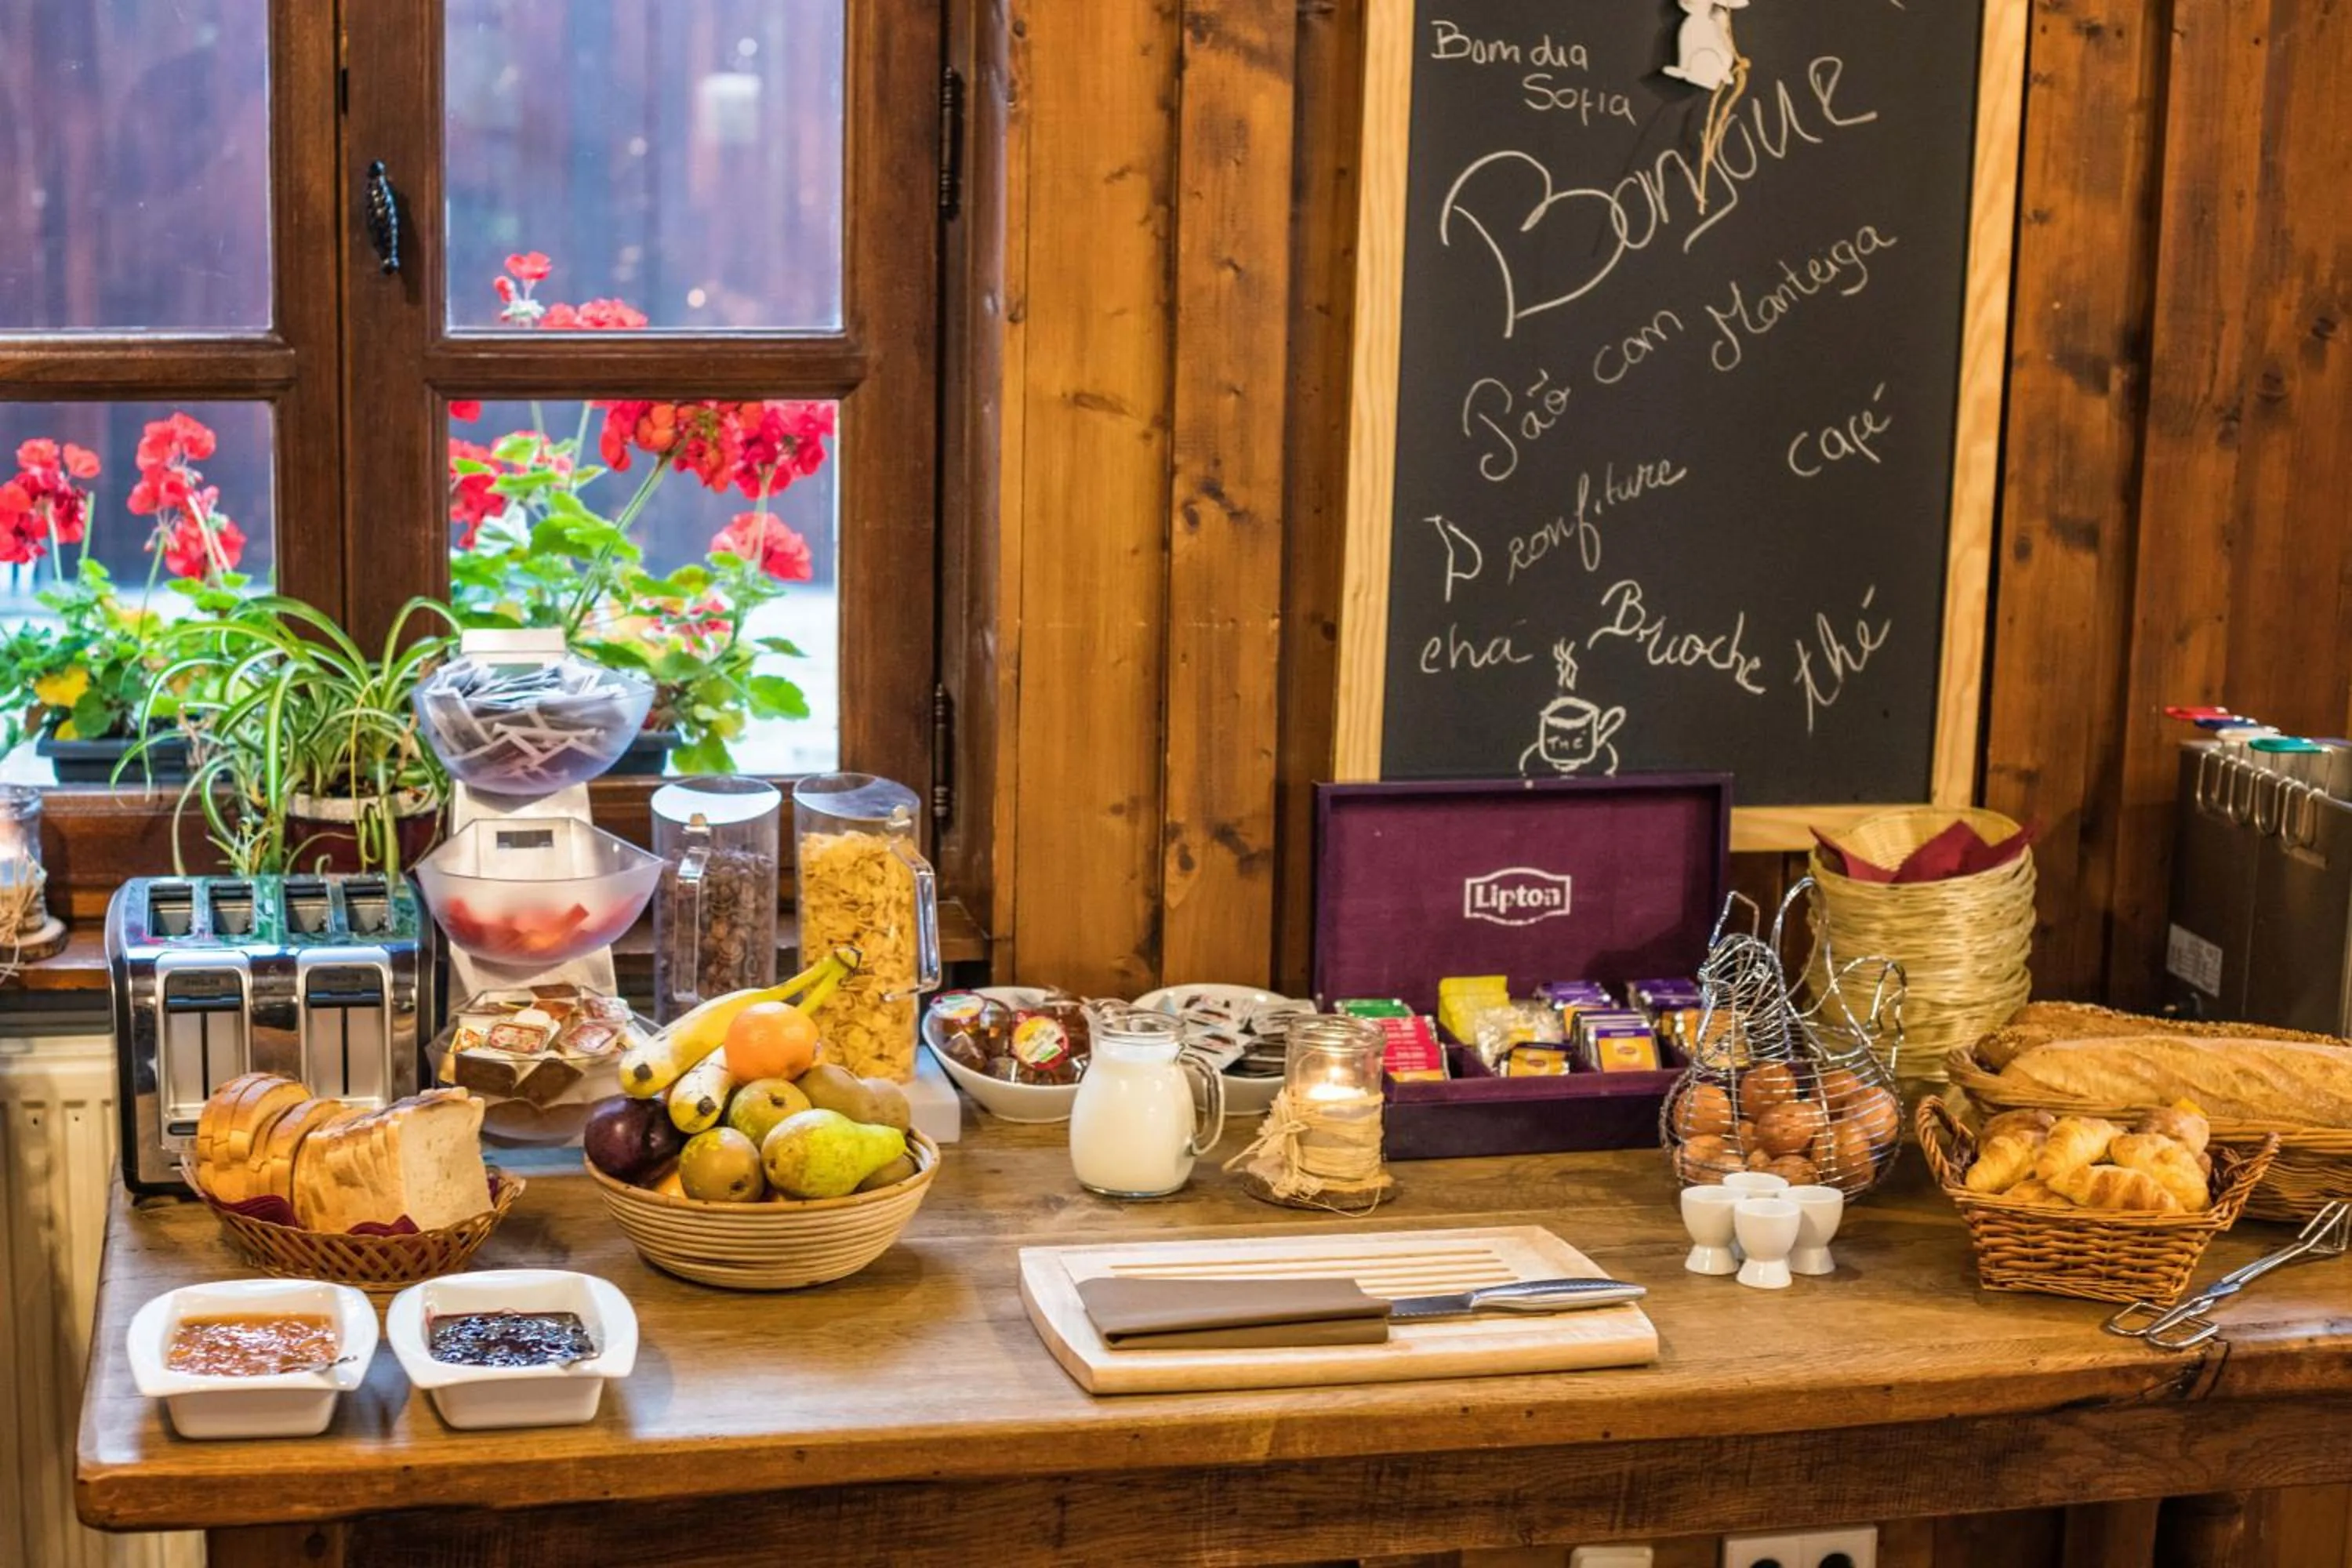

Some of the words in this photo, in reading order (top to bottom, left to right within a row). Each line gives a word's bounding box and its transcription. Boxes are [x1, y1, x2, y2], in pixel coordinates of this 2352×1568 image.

[1430, 20, 1521, 64] Bom
[1530, 34, 1589, 72] dia
[1522, 72, 1638, 127] Sofia
[1711, 225, 1898, 372] Manteiga
[1475, 884, 1562, 915] Lipton
